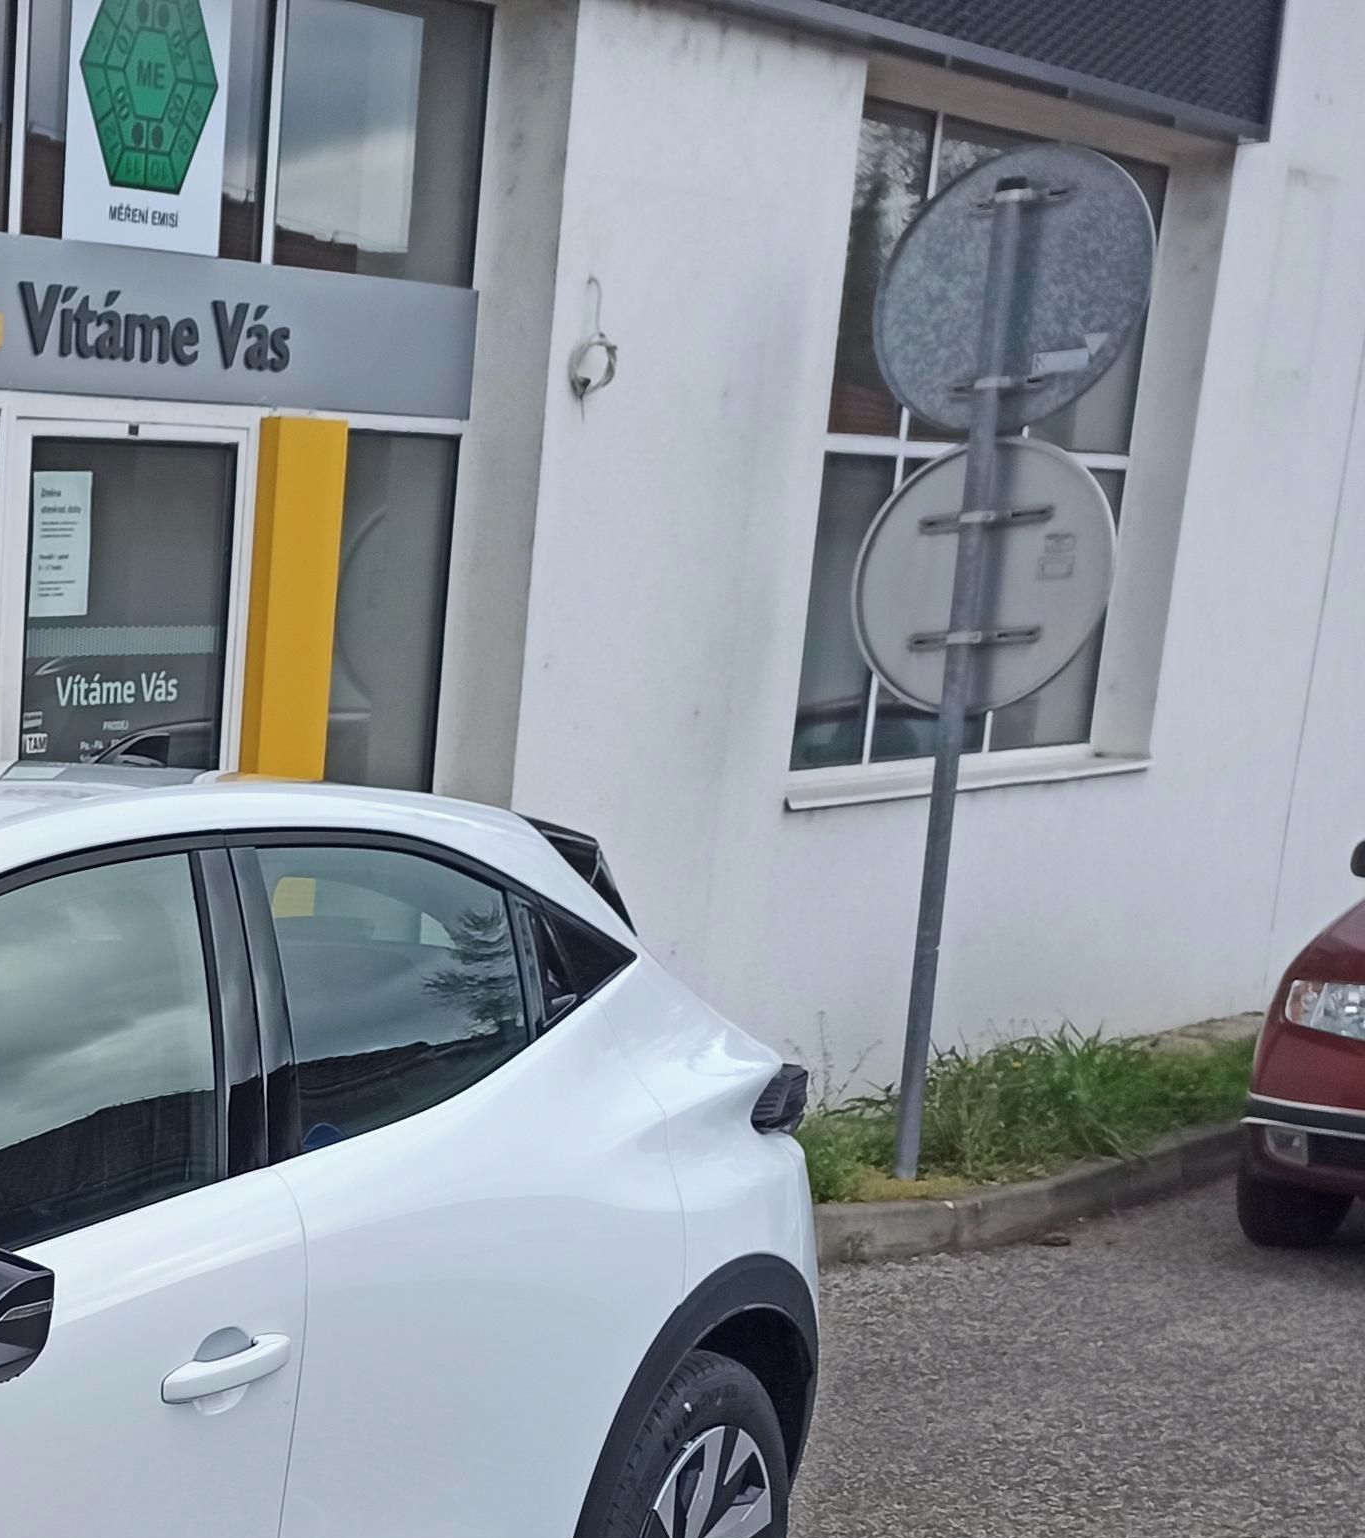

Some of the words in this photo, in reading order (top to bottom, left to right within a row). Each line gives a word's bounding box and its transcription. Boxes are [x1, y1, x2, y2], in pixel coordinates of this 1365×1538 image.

[136, 60, 166, 89] ME
[109, 203, 148, 224] MĚŘENÍ
[151, 207, 179, 228] EMISÍ
[18, 281, 199, 366] Vítáme
[213, 301, 291, 373] Vás
[56, 673, 135, 707] Vítáme
[141, 670, 179, 702] Vás
